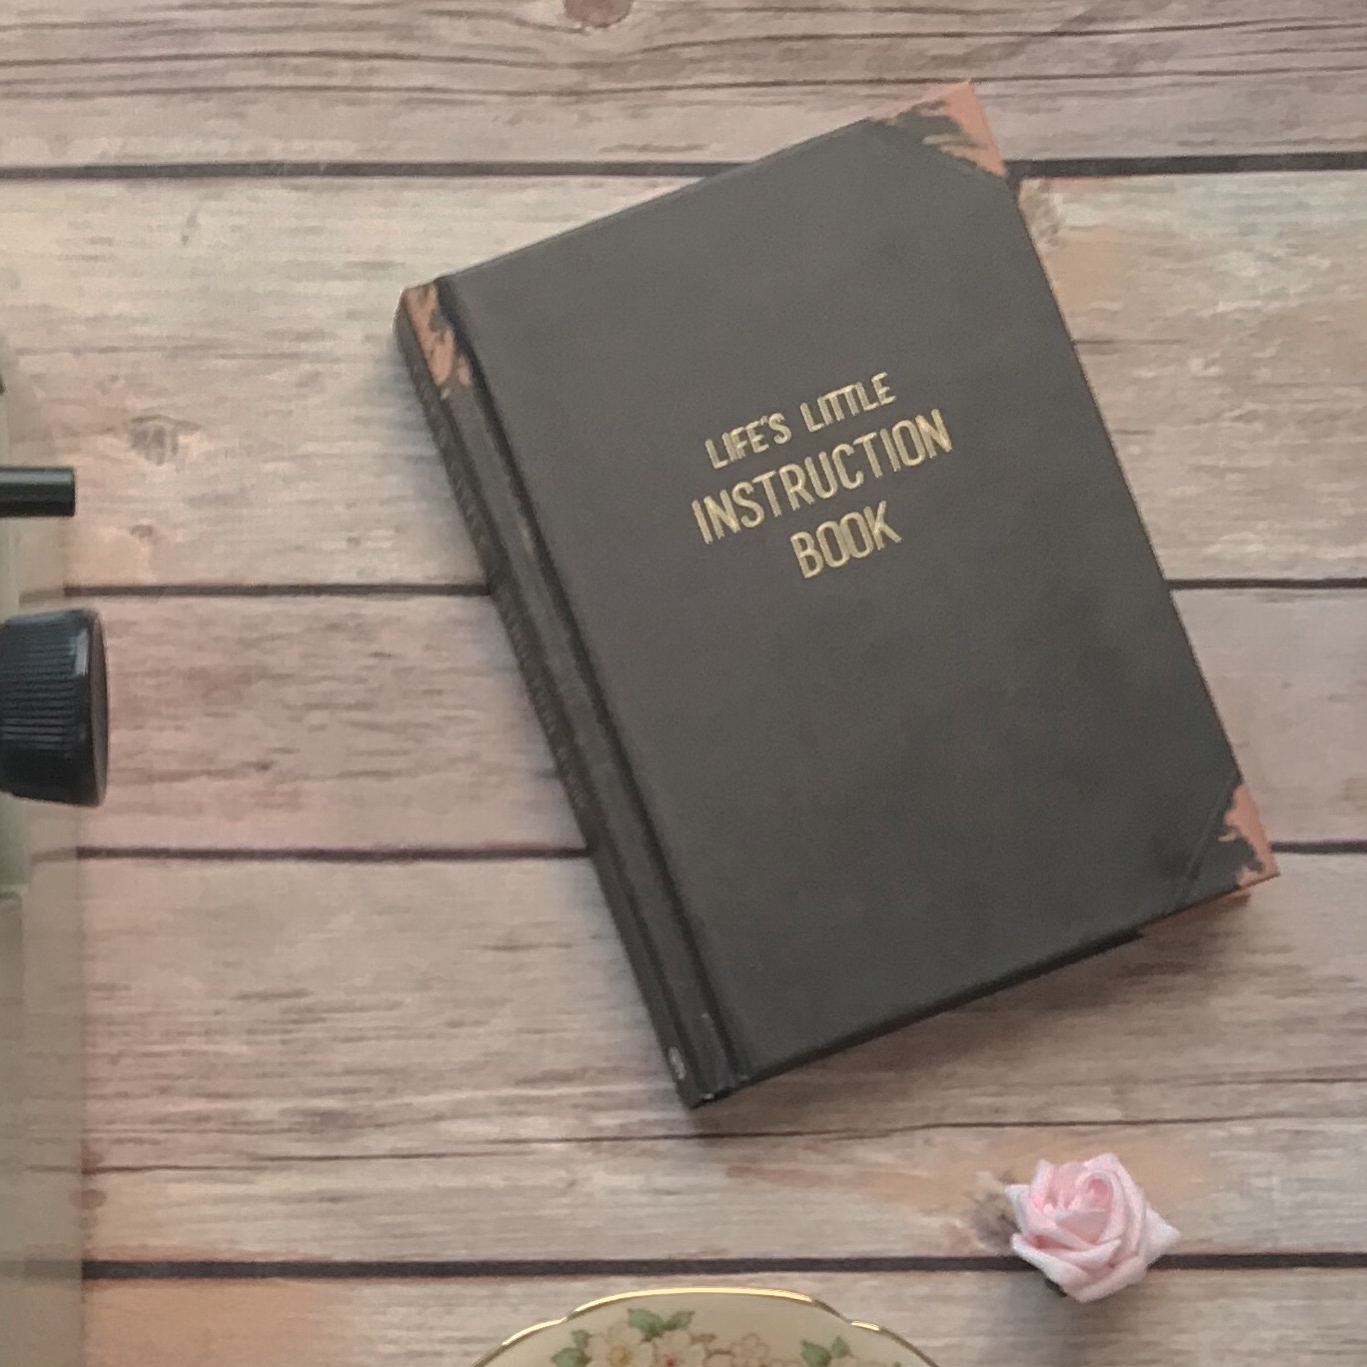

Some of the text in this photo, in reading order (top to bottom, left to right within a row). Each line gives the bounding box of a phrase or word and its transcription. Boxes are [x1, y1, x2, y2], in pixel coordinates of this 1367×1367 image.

[704, 372, 897, 469] LIFE'S LITTLE
[691, 408, 953, 545] INSTRUCTION
[789, 500, 903, 579] BOOK
